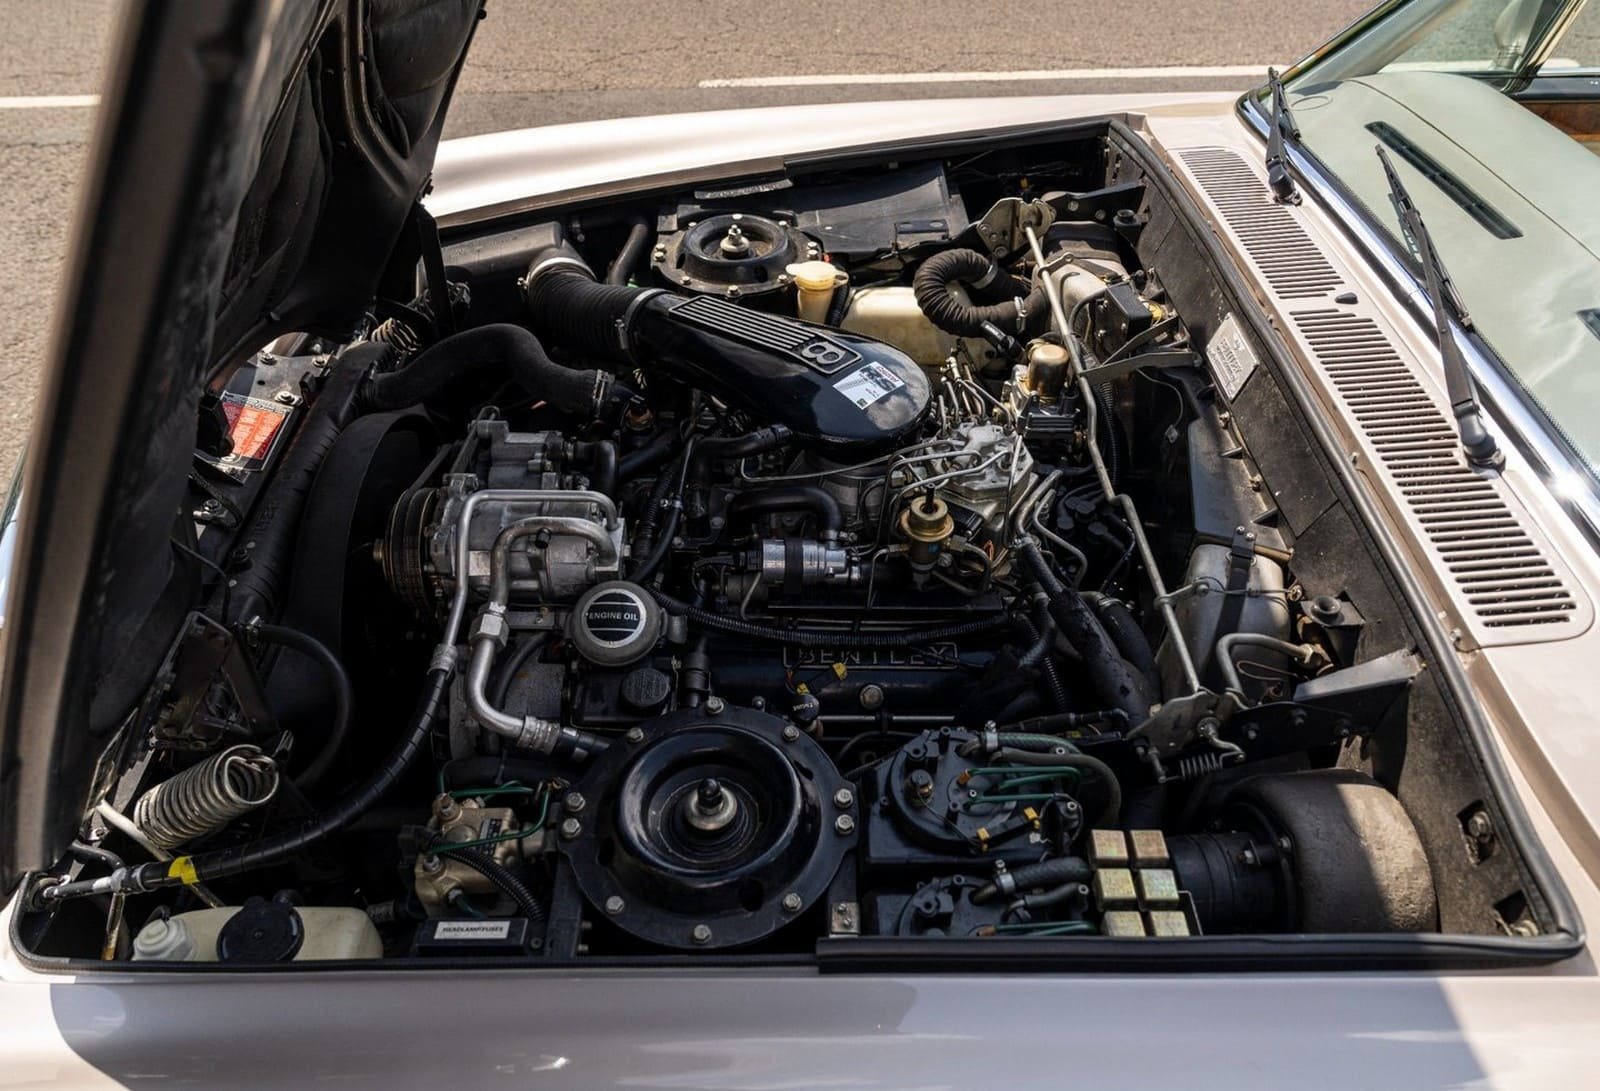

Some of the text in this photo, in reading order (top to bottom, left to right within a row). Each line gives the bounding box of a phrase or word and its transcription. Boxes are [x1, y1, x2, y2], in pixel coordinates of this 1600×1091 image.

[801, 341, 847, 365] 8
[588, 611, 639, 621] ENGINE OIL
